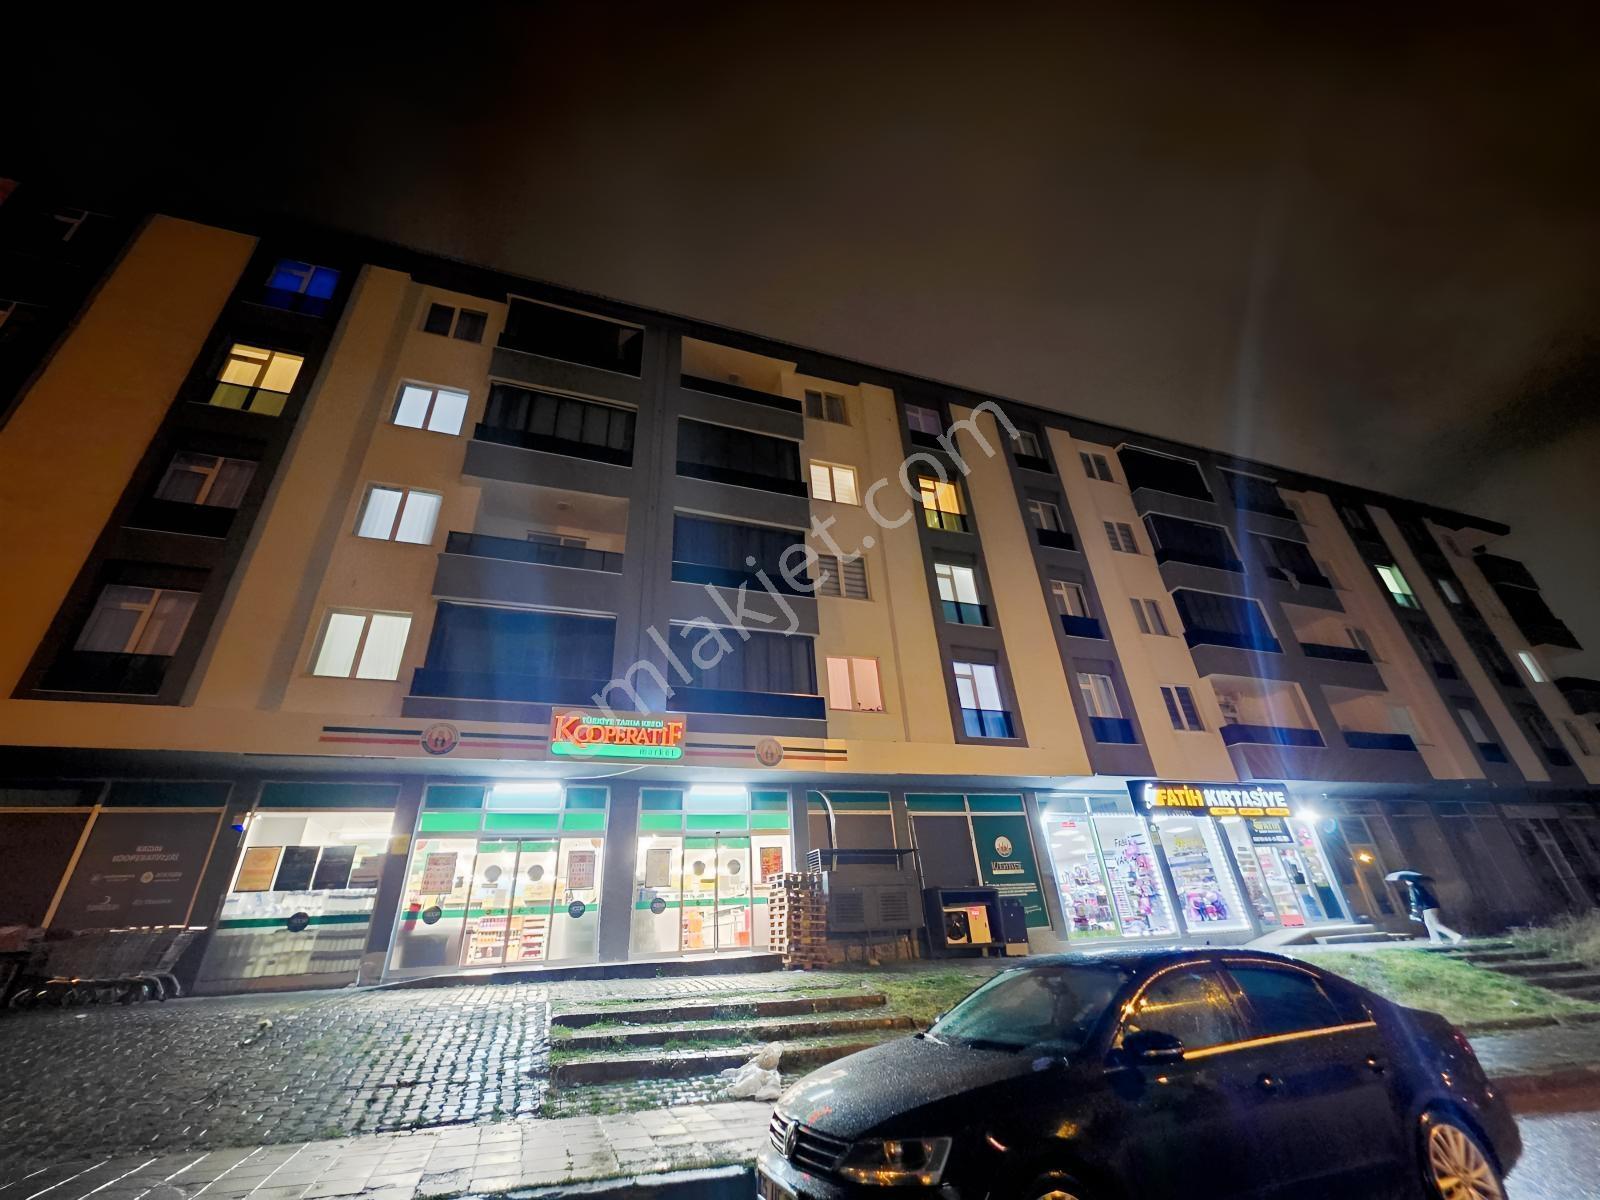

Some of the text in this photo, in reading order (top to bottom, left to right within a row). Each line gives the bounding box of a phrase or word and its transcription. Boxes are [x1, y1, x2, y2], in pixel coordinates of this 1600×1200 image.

[552, 714, 683, 748] KOOPERATİF
[1156, 785, 1287, 807] FATİH KIRTASİYE
